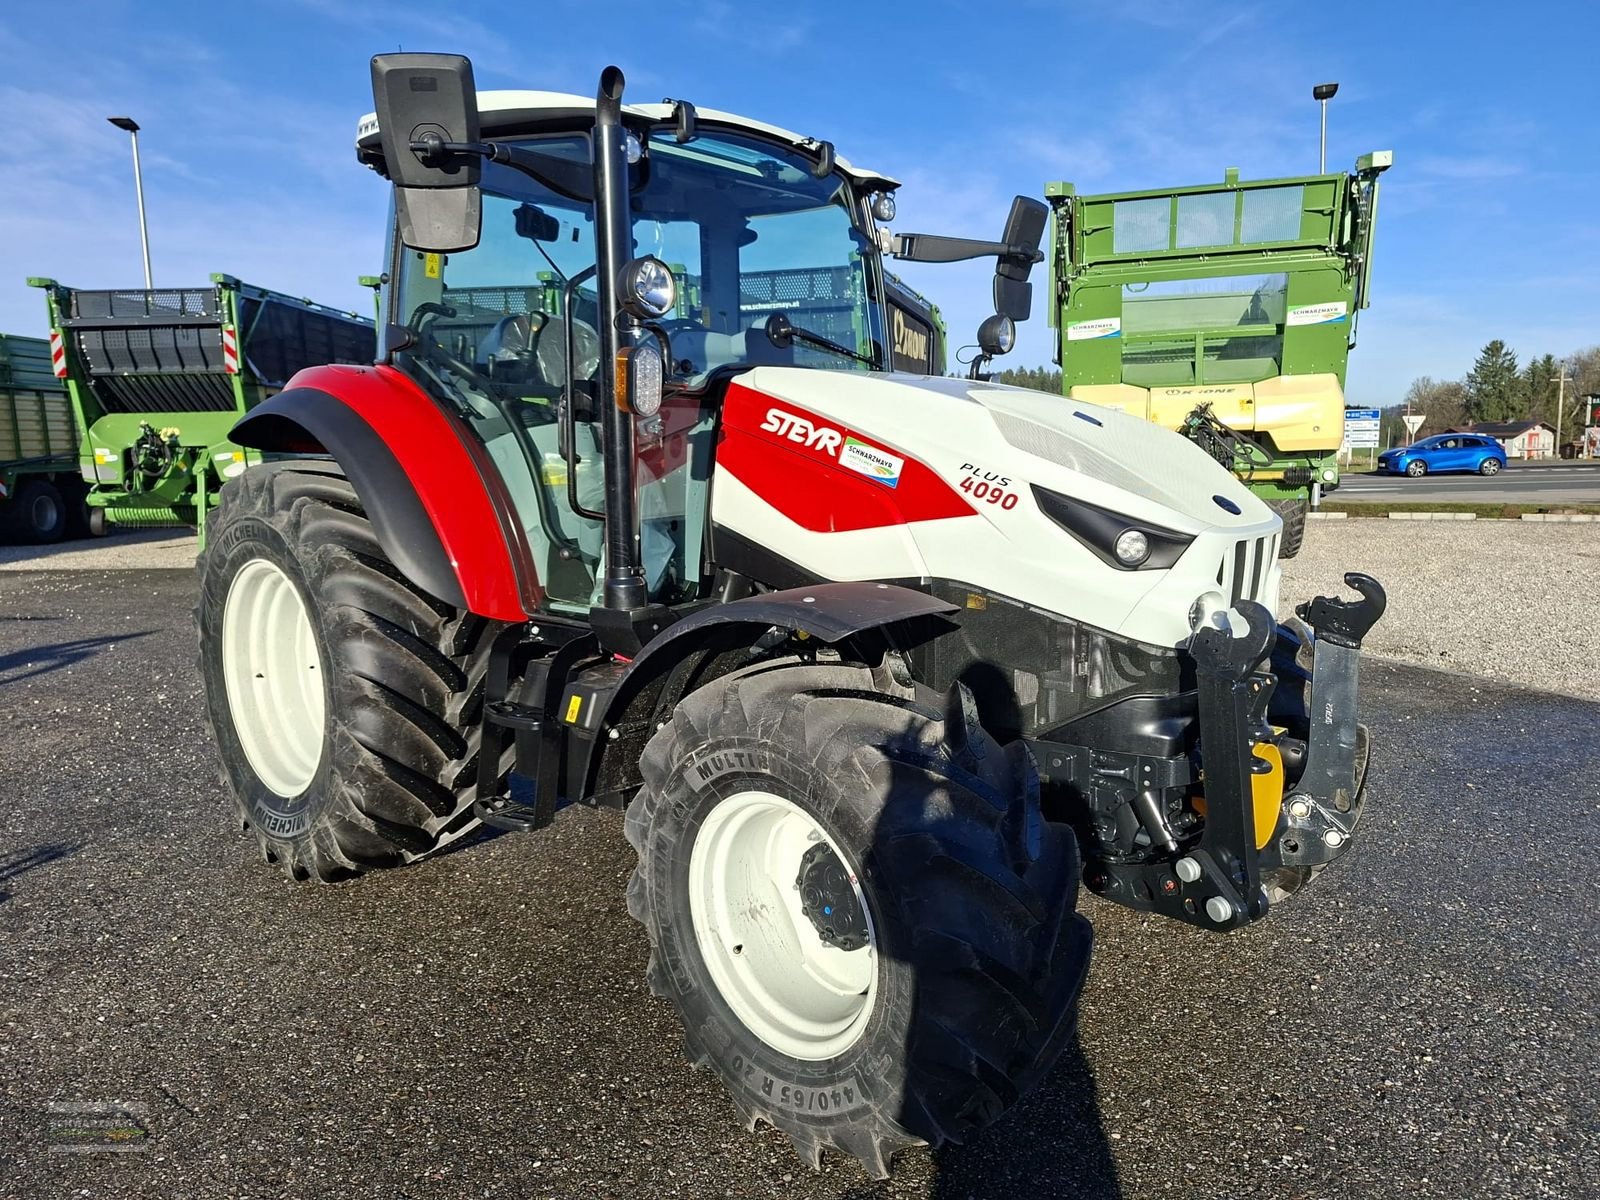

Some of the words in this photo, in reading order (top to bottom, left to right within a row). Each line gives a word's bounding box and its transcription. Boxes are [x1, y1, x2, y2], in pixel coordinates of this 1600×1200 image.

[759, 407, 842, 457] STEYR
[848, 445, 894, 469] SCHWARZMAYR
[959, 462, 1013, 487] PLUS
[959, 476, 1019, 511] 4090
[222, 524, 271, 551] MICHELIN
[255, 806, 307, 834] MICHELIN
[731, 1054, 756, 1079] 20
[761, 1075, 775, 1098] R
[779, 1085, 855, 1112] 440/65
